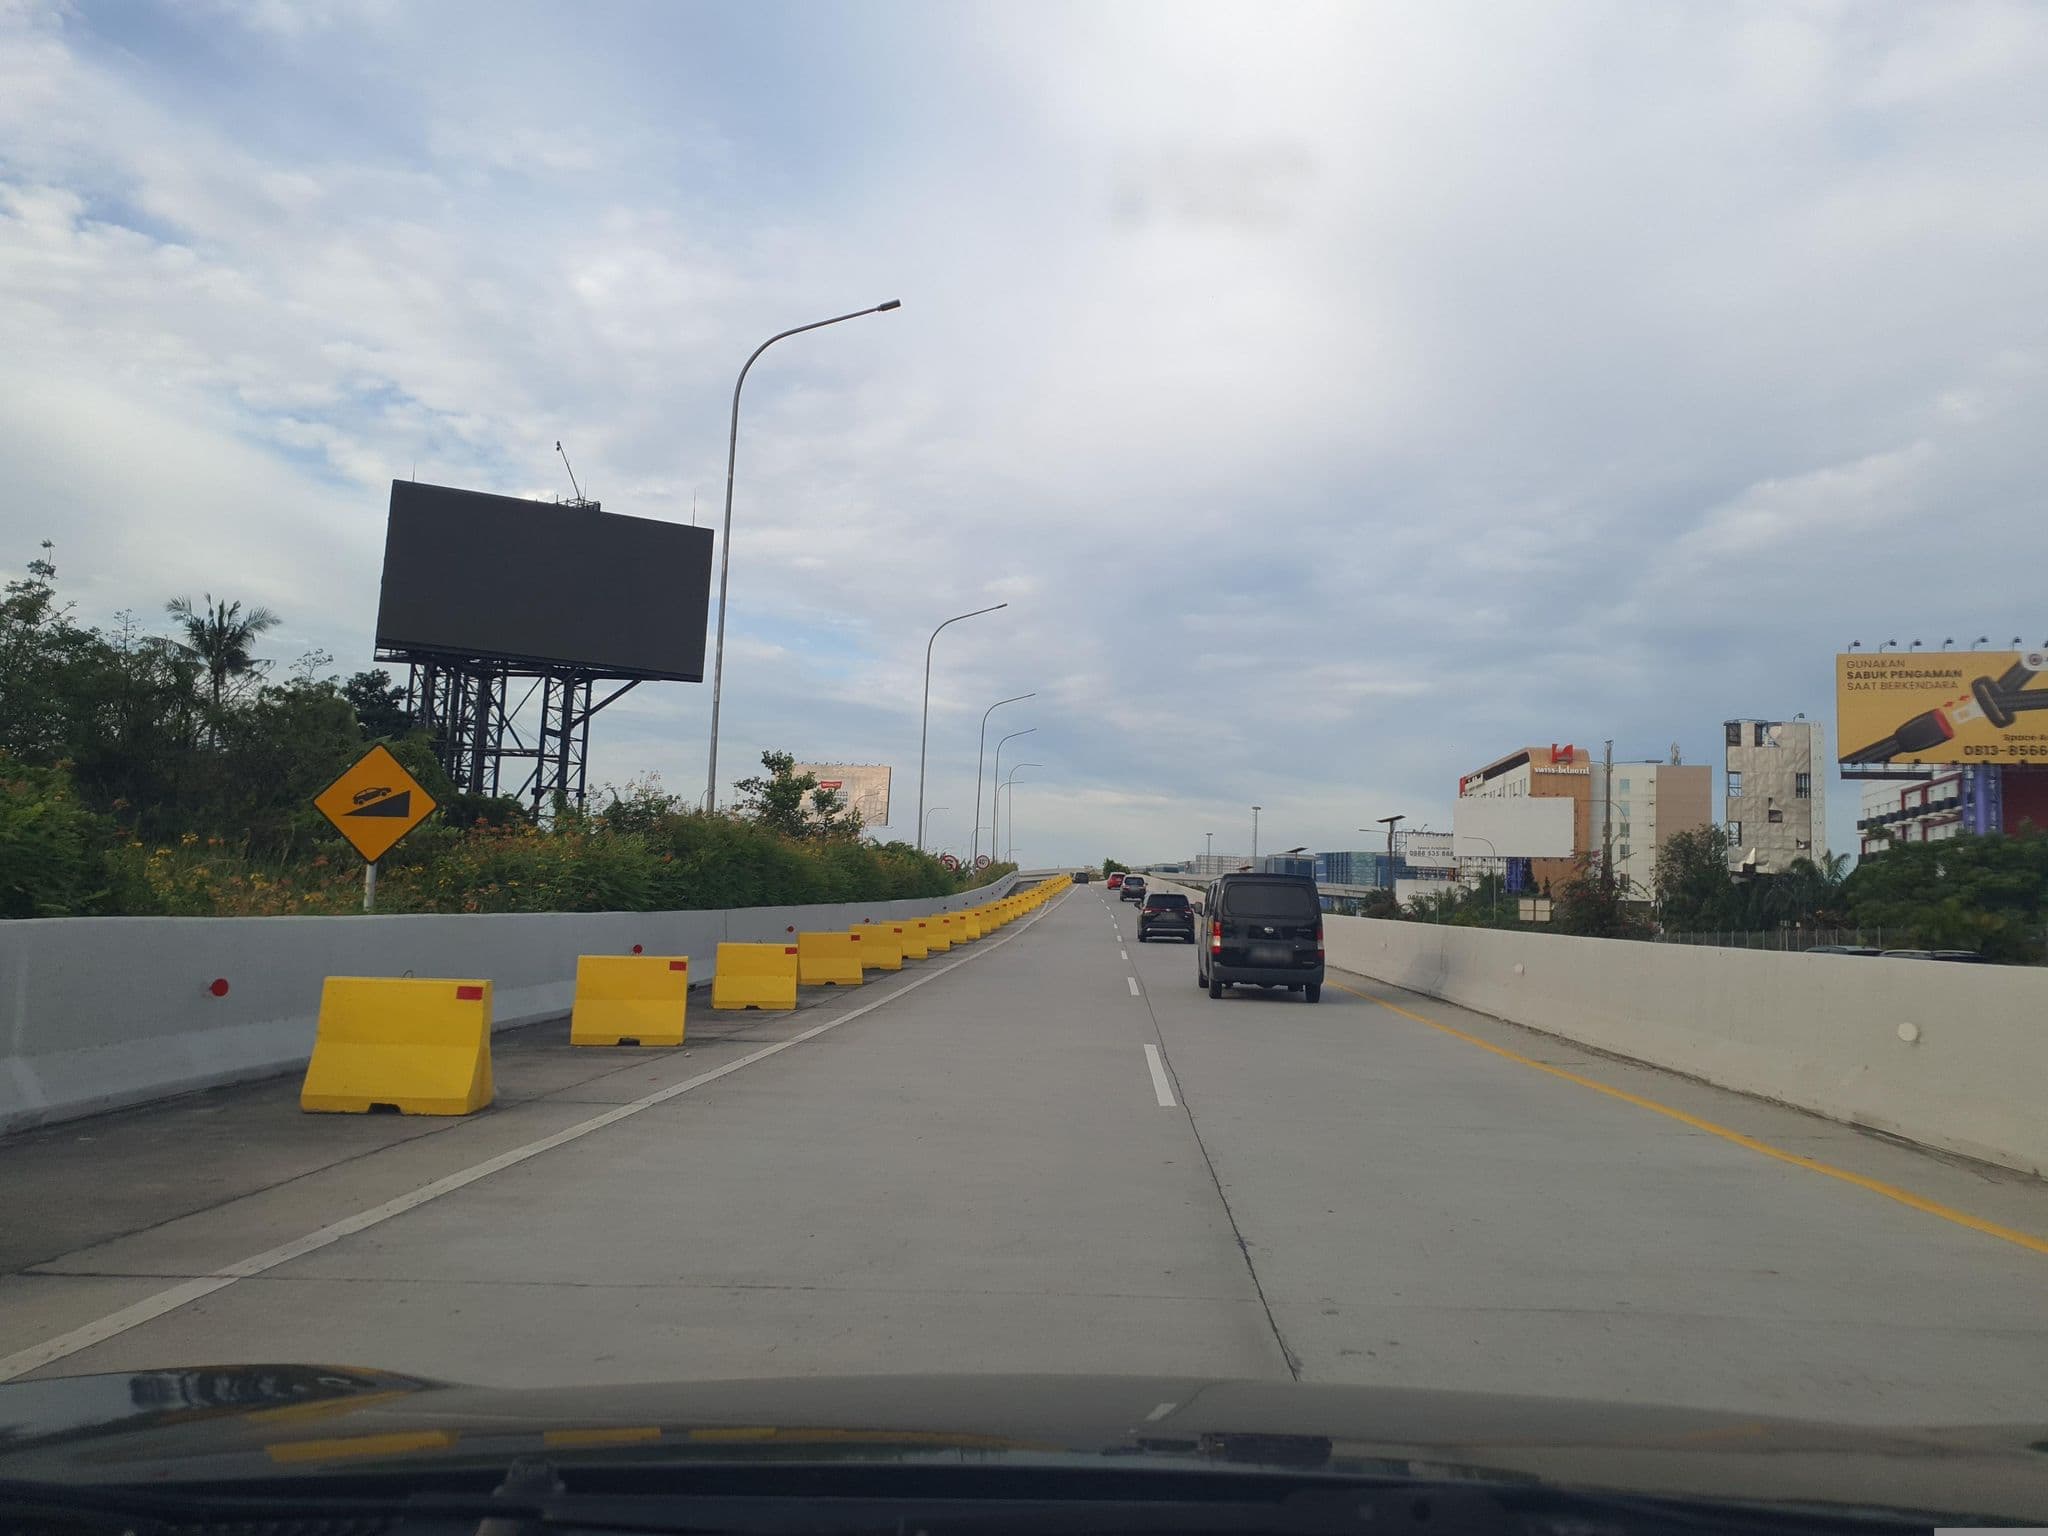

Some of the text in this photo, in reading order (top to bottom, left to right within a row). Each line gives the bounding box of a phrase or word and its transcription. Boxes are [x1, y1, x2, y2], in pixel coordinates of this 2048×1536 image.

[1847, 659, 1905, 668] GUNAKAN
[1847, 669, 1962, 680] SABUK PENGAMAN
[1847, 680, 1958, 690] SAAT BERKENDARA
